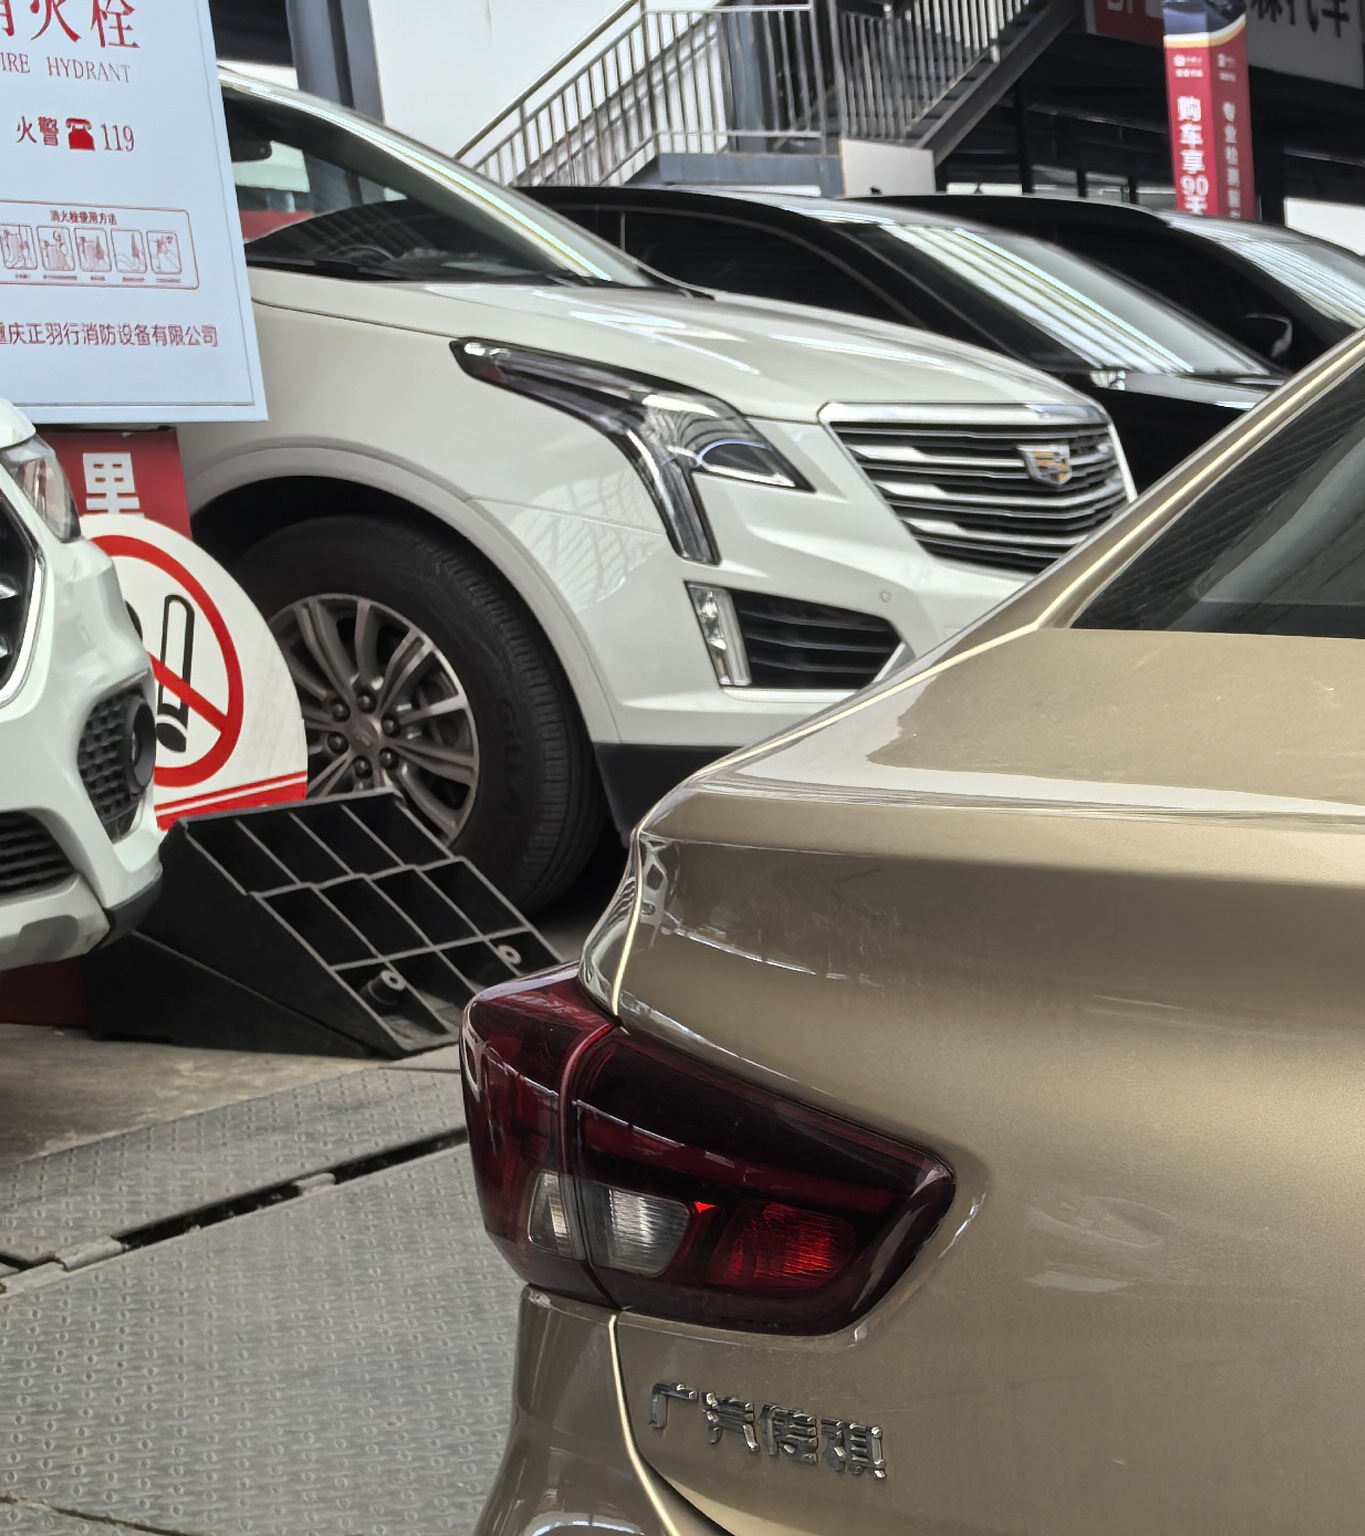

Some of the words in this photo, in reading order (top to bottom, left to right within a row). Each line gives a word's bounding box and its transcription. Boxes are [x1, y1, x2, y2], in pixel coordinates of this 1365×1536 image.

[0, 0, 140, 48] 火栓
[0, 52, 31, 74] IRE
[46, 56, 131, 83] HYDRANT
[16, 116, 59, 146] 火警
[101, 123, 135, 152] 119
